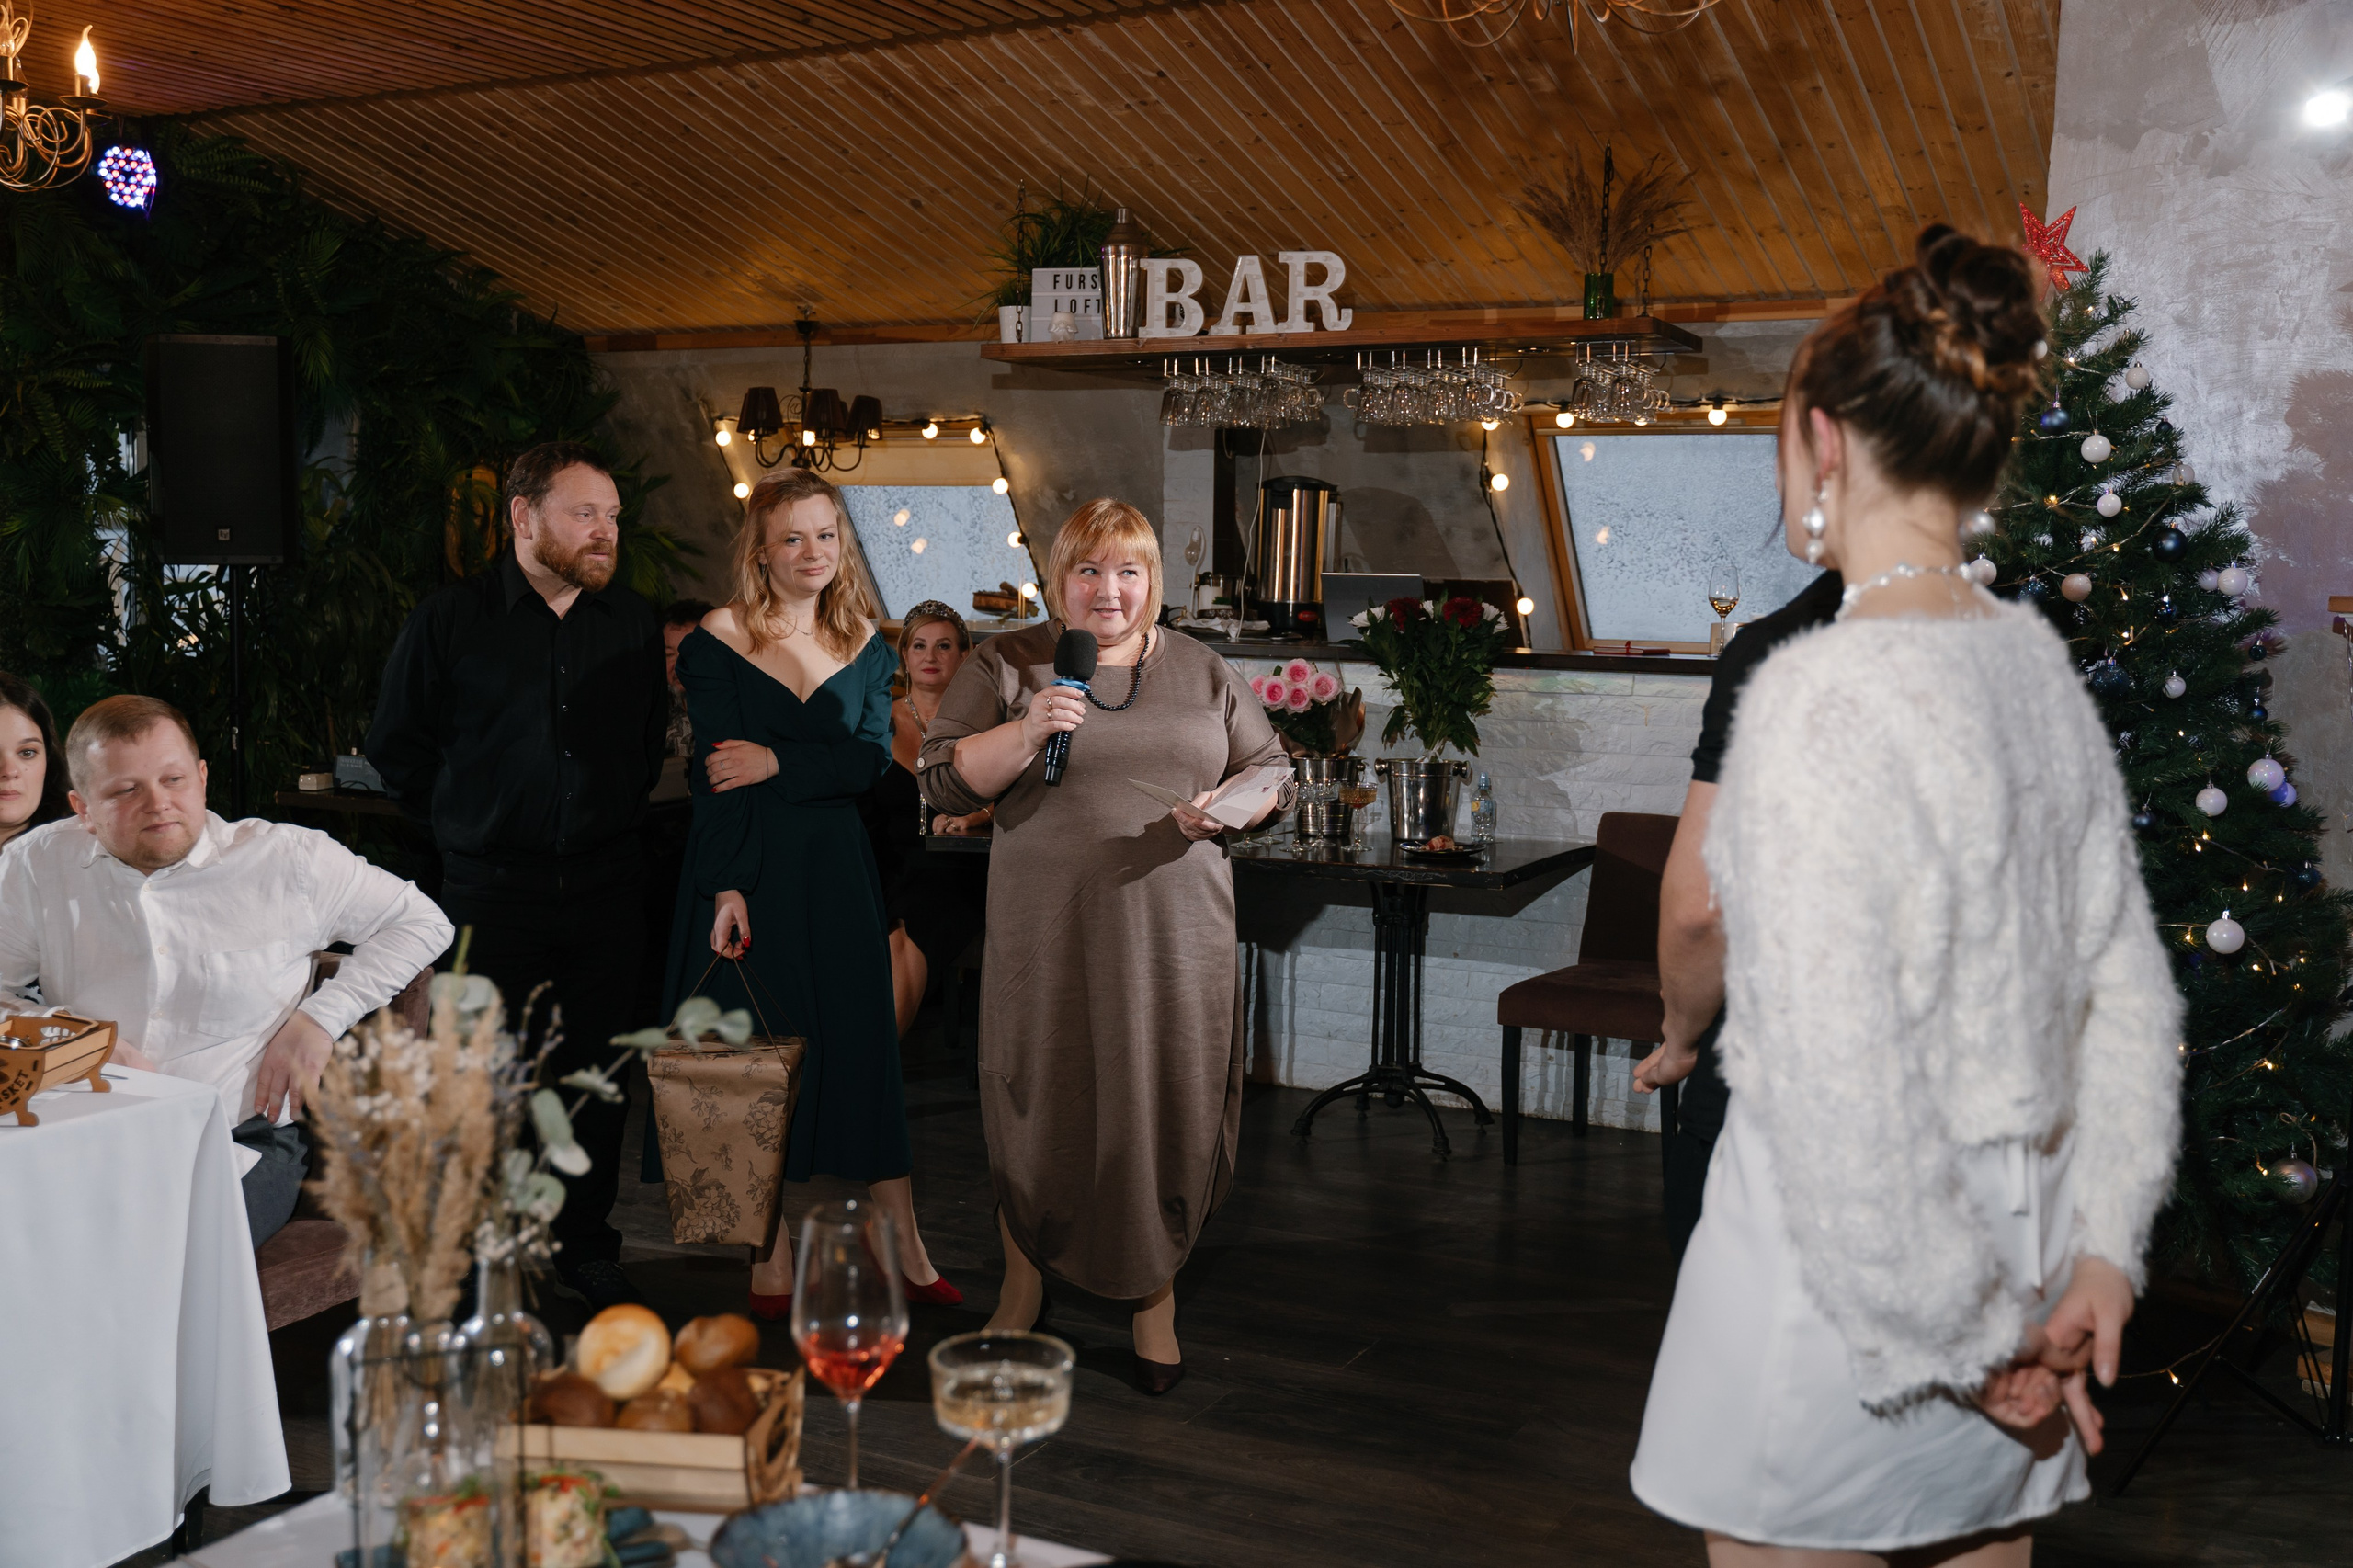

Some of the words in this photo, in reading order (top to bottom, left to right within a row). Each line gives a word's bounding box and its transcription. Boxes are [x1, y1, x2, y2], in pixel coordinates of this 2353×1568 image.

[1053, 274, 1097, 290] FURS
[1139, 251, 1353, 337] BAR
[0, 1069, 28, 1102] SKET
